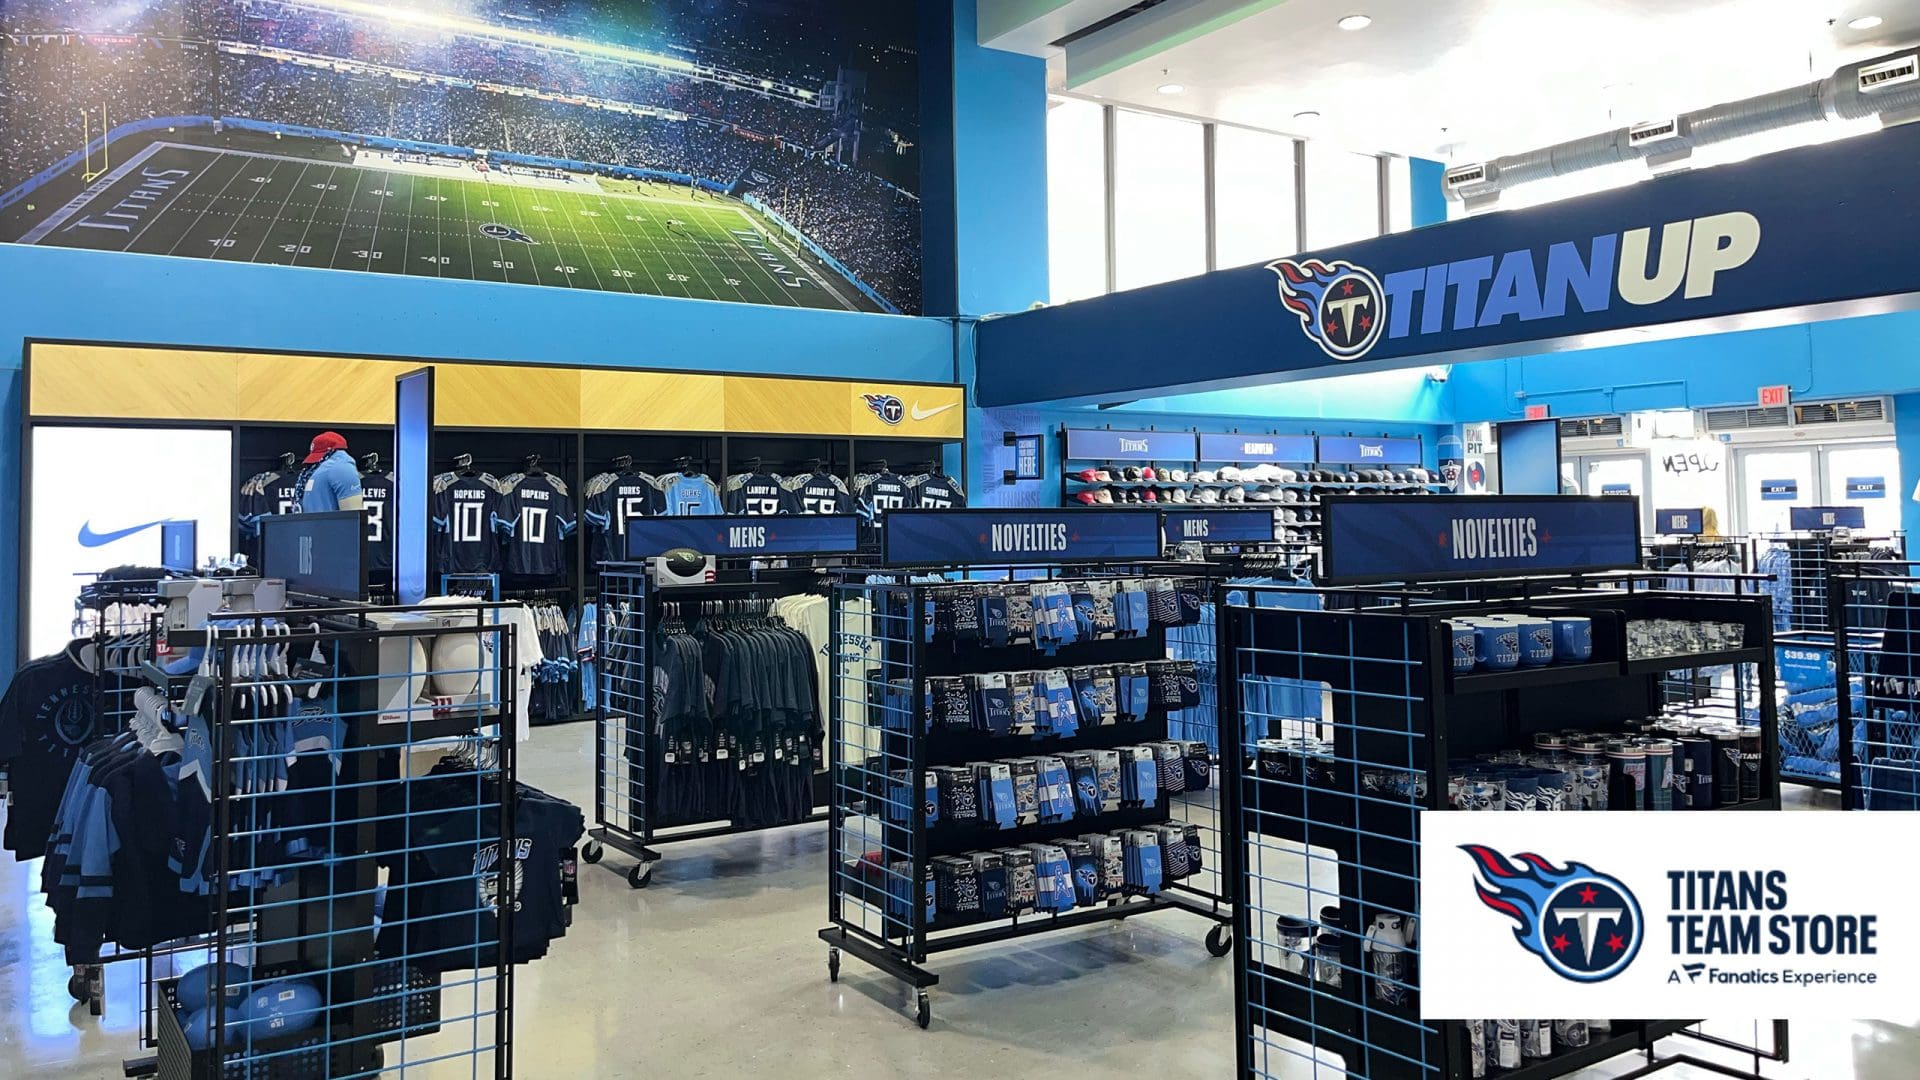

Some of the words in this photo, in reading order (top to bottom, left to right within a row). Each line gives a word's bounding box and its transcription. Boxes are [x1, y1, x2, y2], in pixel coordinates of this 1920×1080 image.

[1762, 386, 1785, 406] EXIT
[1118, 437, 1149, 453] TITANS
[1359, 444, 1383, 458] TITANS
[1467, 442, 1483, 454] PIT
[363, 487, 387, 498] LEVIS
[453, 489, 486, 500] HOPKINS
[521, 488, 550, 500] HOPKINS
[746, 486, 770, 495] LANDRY
[805, 486, 828, 496] LANDRY
[454, 502, 485, 542] 10
[522, 506, 549, 543] 10
[1183, 519, 1209, 537] MENS
[729, 526, 766, 548] MENS
[991, 523, 1068, 552] NOVELTIES
[1451, 517, 1538, 560] NOVELTIES
